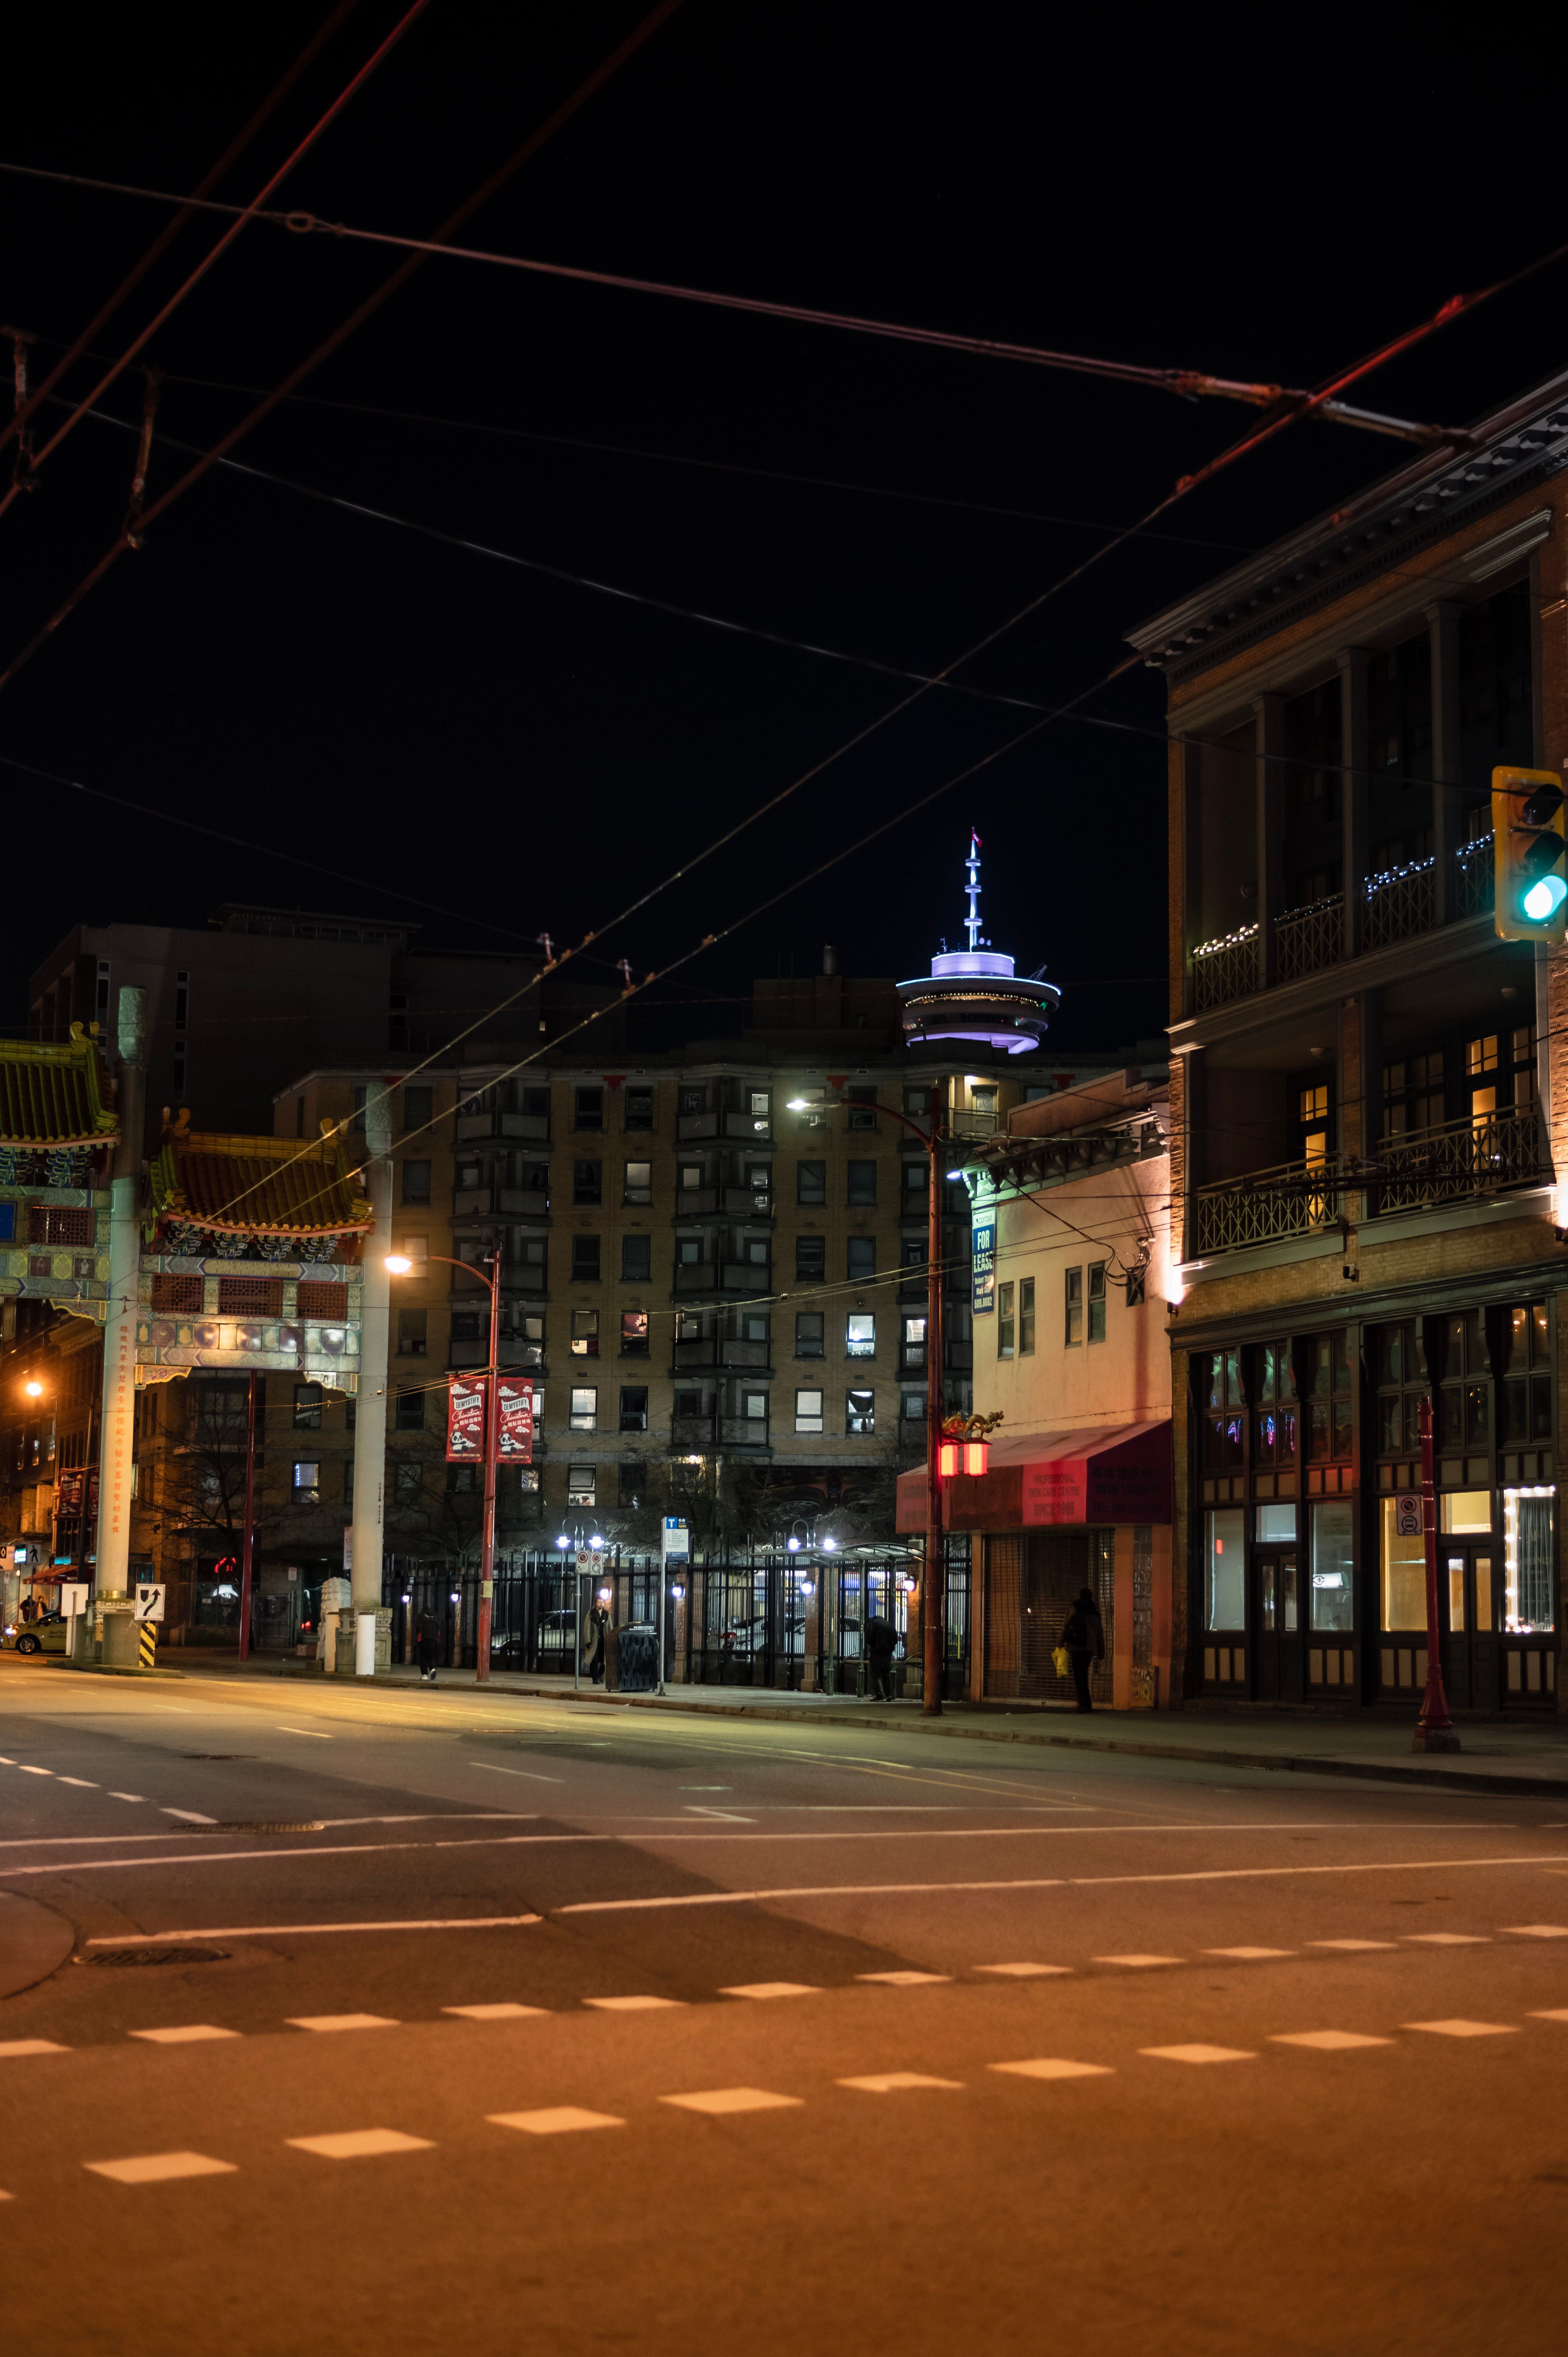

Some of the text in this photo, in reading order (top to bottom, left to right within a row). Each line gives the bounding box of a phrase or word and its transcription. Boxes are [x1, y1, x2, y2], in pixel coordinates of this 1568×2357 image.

[978, 1212, 992, 1224] corbel
[977, 1230, 990, 1250] FOR
[973, 1251, 993, 1273] LEASE
[975, 1296, 992, 1309] 609.0882
[456, 1397, 479, 1408] DEMYSTIFY
[504, 1399, 527, 1410] DEMYSTIFY
[452, 1408, 482, 1421] Chinatown
[500, 1410, 531, 1423] Chinatown
[1034, 1502, 1055, 1517] SINCE
[668, 1519, 675, 1528] T
